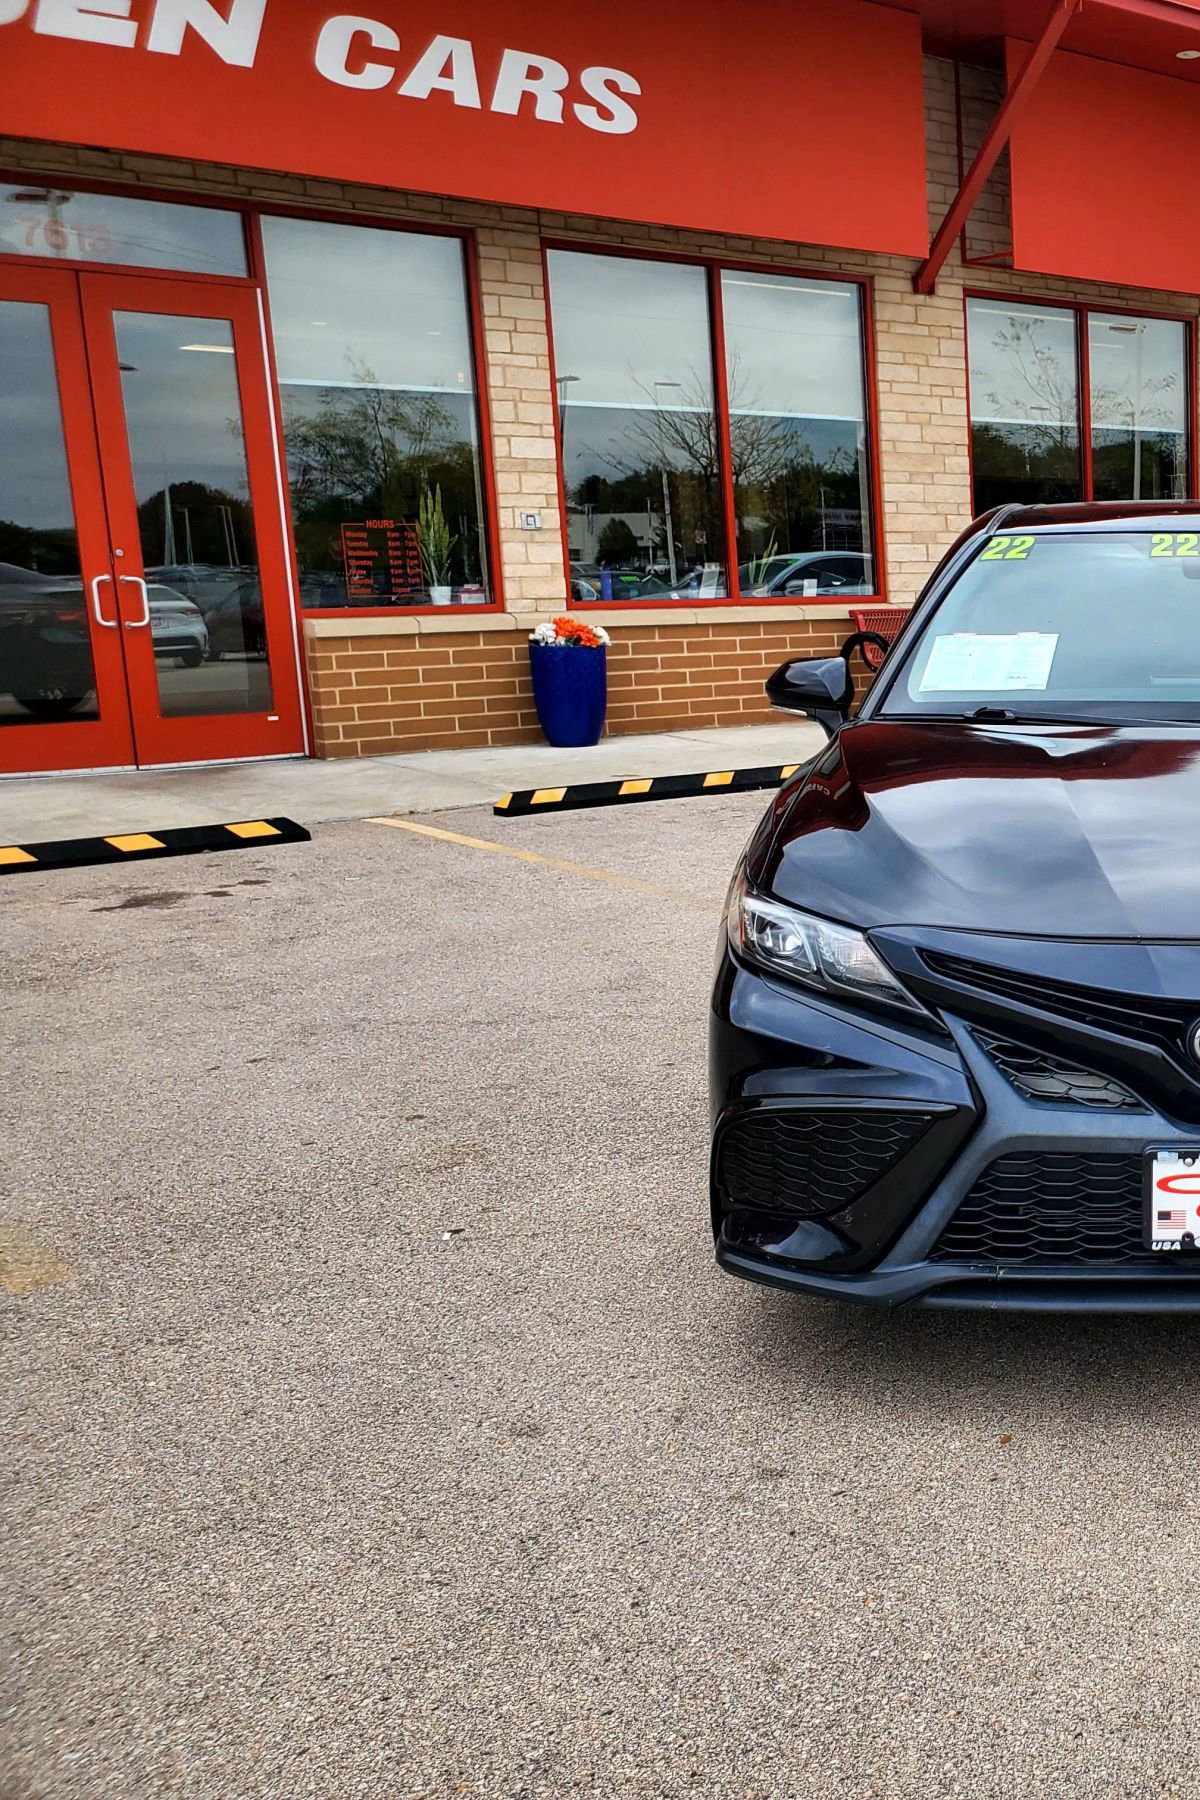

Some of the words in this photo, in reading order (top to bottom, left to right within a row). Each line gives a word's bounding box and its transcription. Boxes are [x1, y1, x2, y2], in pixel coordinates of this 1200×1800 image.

[0, 0, 266, 68] EN
[314, 15, 641, 134] CARS
[366, 520, 395, 528] HOURS
[980, 536, 1035, 561] 22
[1152, 1241, 1181, 1250] USA
